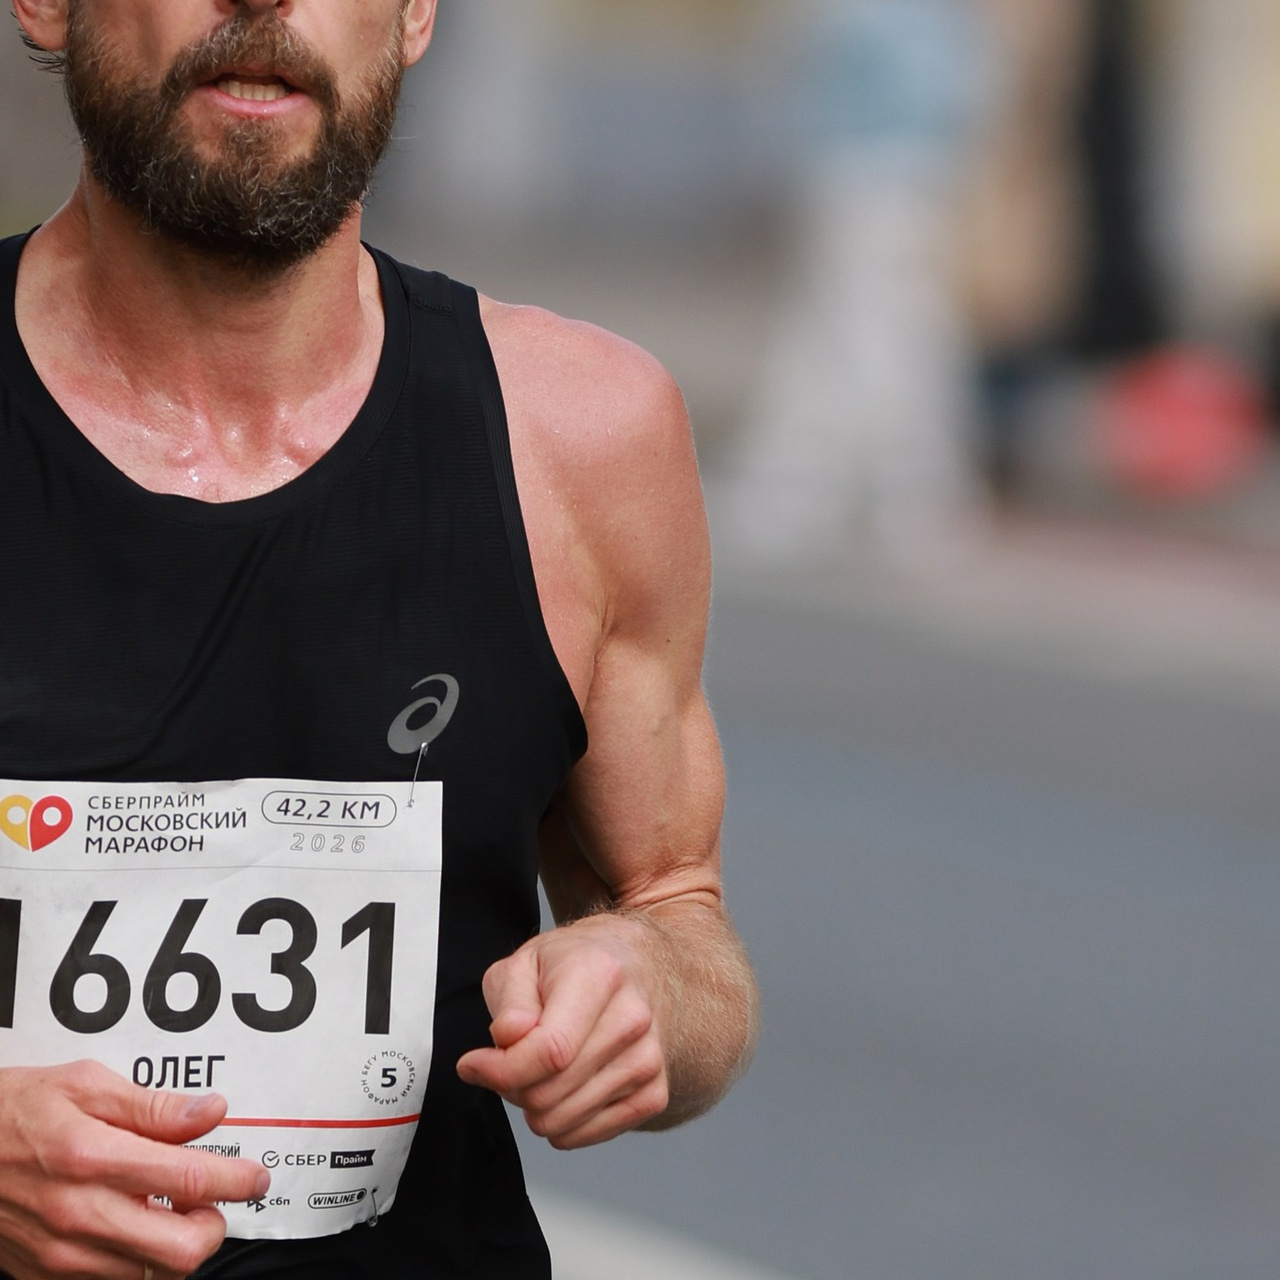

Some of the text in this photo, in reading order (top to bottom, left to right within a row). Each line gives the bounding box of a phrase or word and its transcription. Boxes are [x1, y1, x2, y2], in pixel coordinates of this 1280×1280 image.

[88, 791, 205, 810] СБЕРПРАЙМ
[276, 798, 331, 820] 42,2
[86, 807, 247, 832] МОСКОВСКИЙ
[85, 835, 205, 854] МАРАФОН
[290, 832, 366, 854] 2026
[133, 1055, 225, 1088] ОЛЕГ
[361, 1050, 416, 1105] БЕГУ МОСКОВСКИЙ МАРАФОН
[381, 1067, 397, 1088] 5
[284, 1154, 367, 1166] СБЕР Прайм
[269, 1197, 291, 1206] сбп
[313, 1194, 356, 1206] WINLINE
